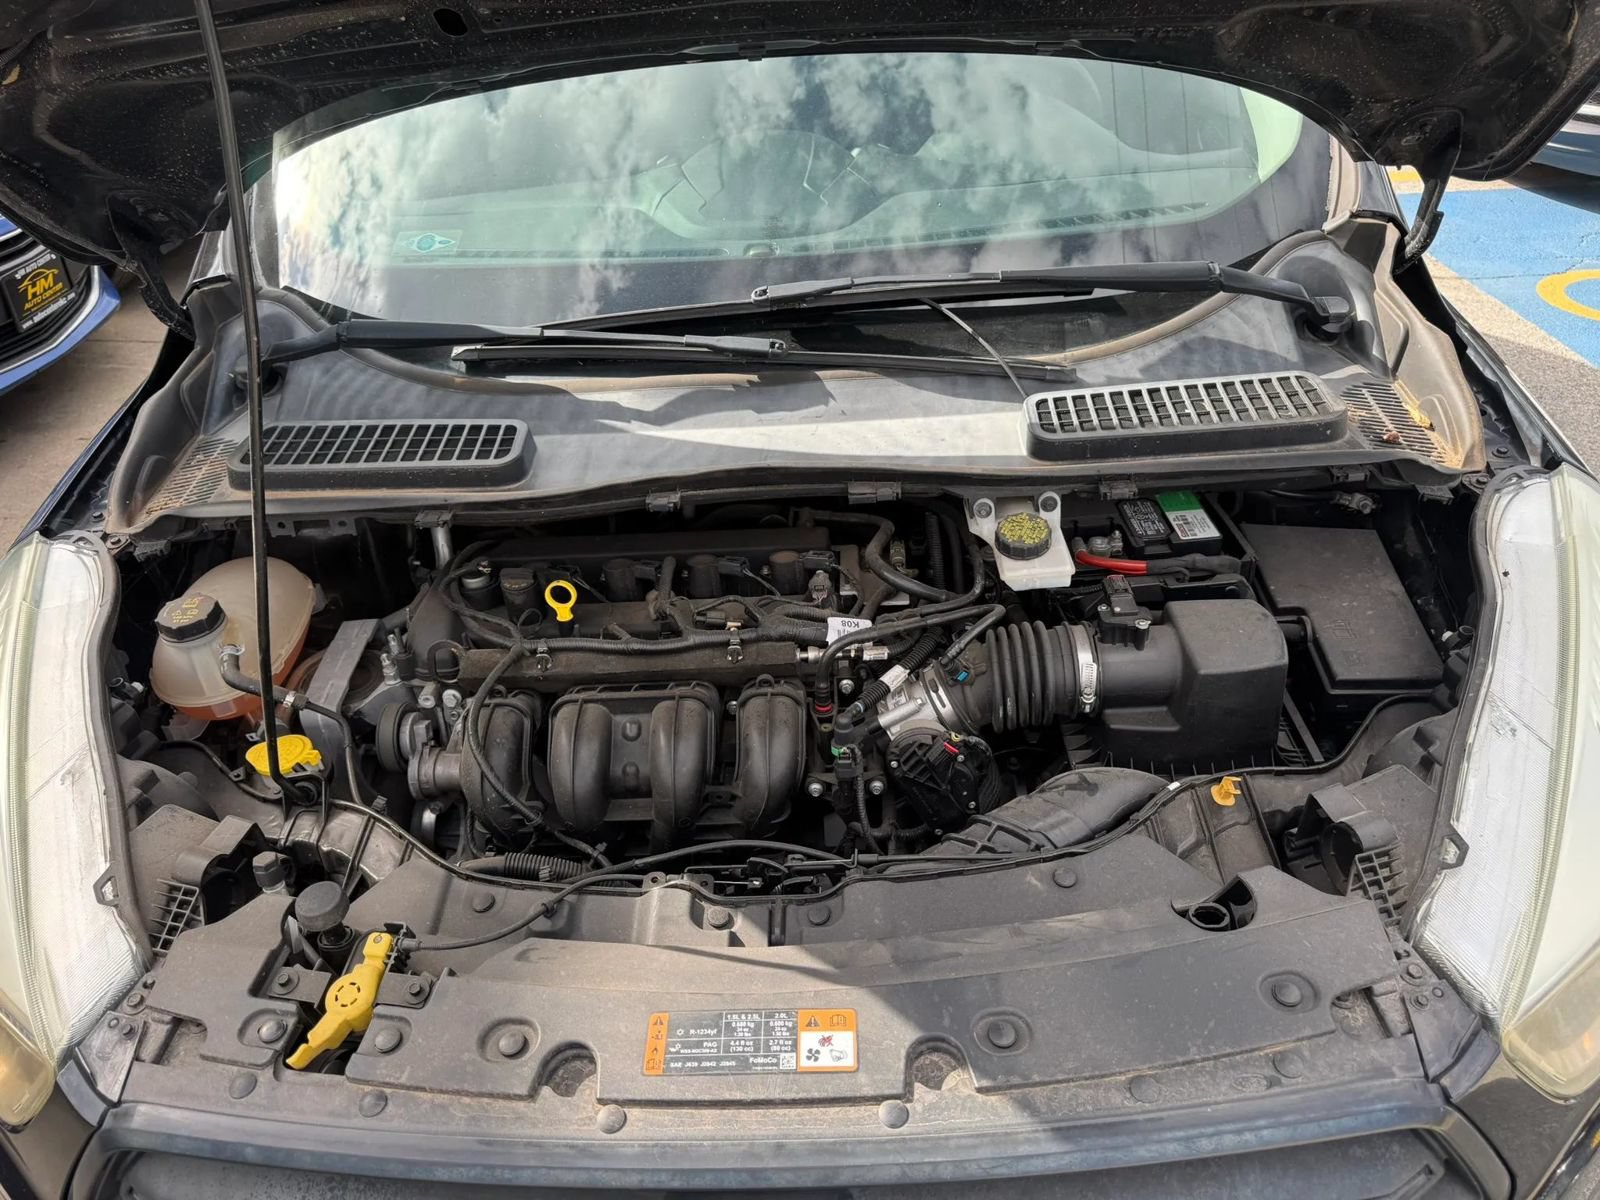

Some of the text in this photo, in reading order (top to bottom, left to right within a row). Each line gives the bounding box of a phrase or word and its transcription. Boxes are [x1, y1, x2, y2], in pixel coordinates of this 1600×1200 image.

[27, 273, 54, 300] HM
[24, 295, 42, 310] AUTO
[42, 282, 63, 299] CENTER
[840, 619, 860, 629] K08
[689, 1028, 717, 1036] R-1234yf
